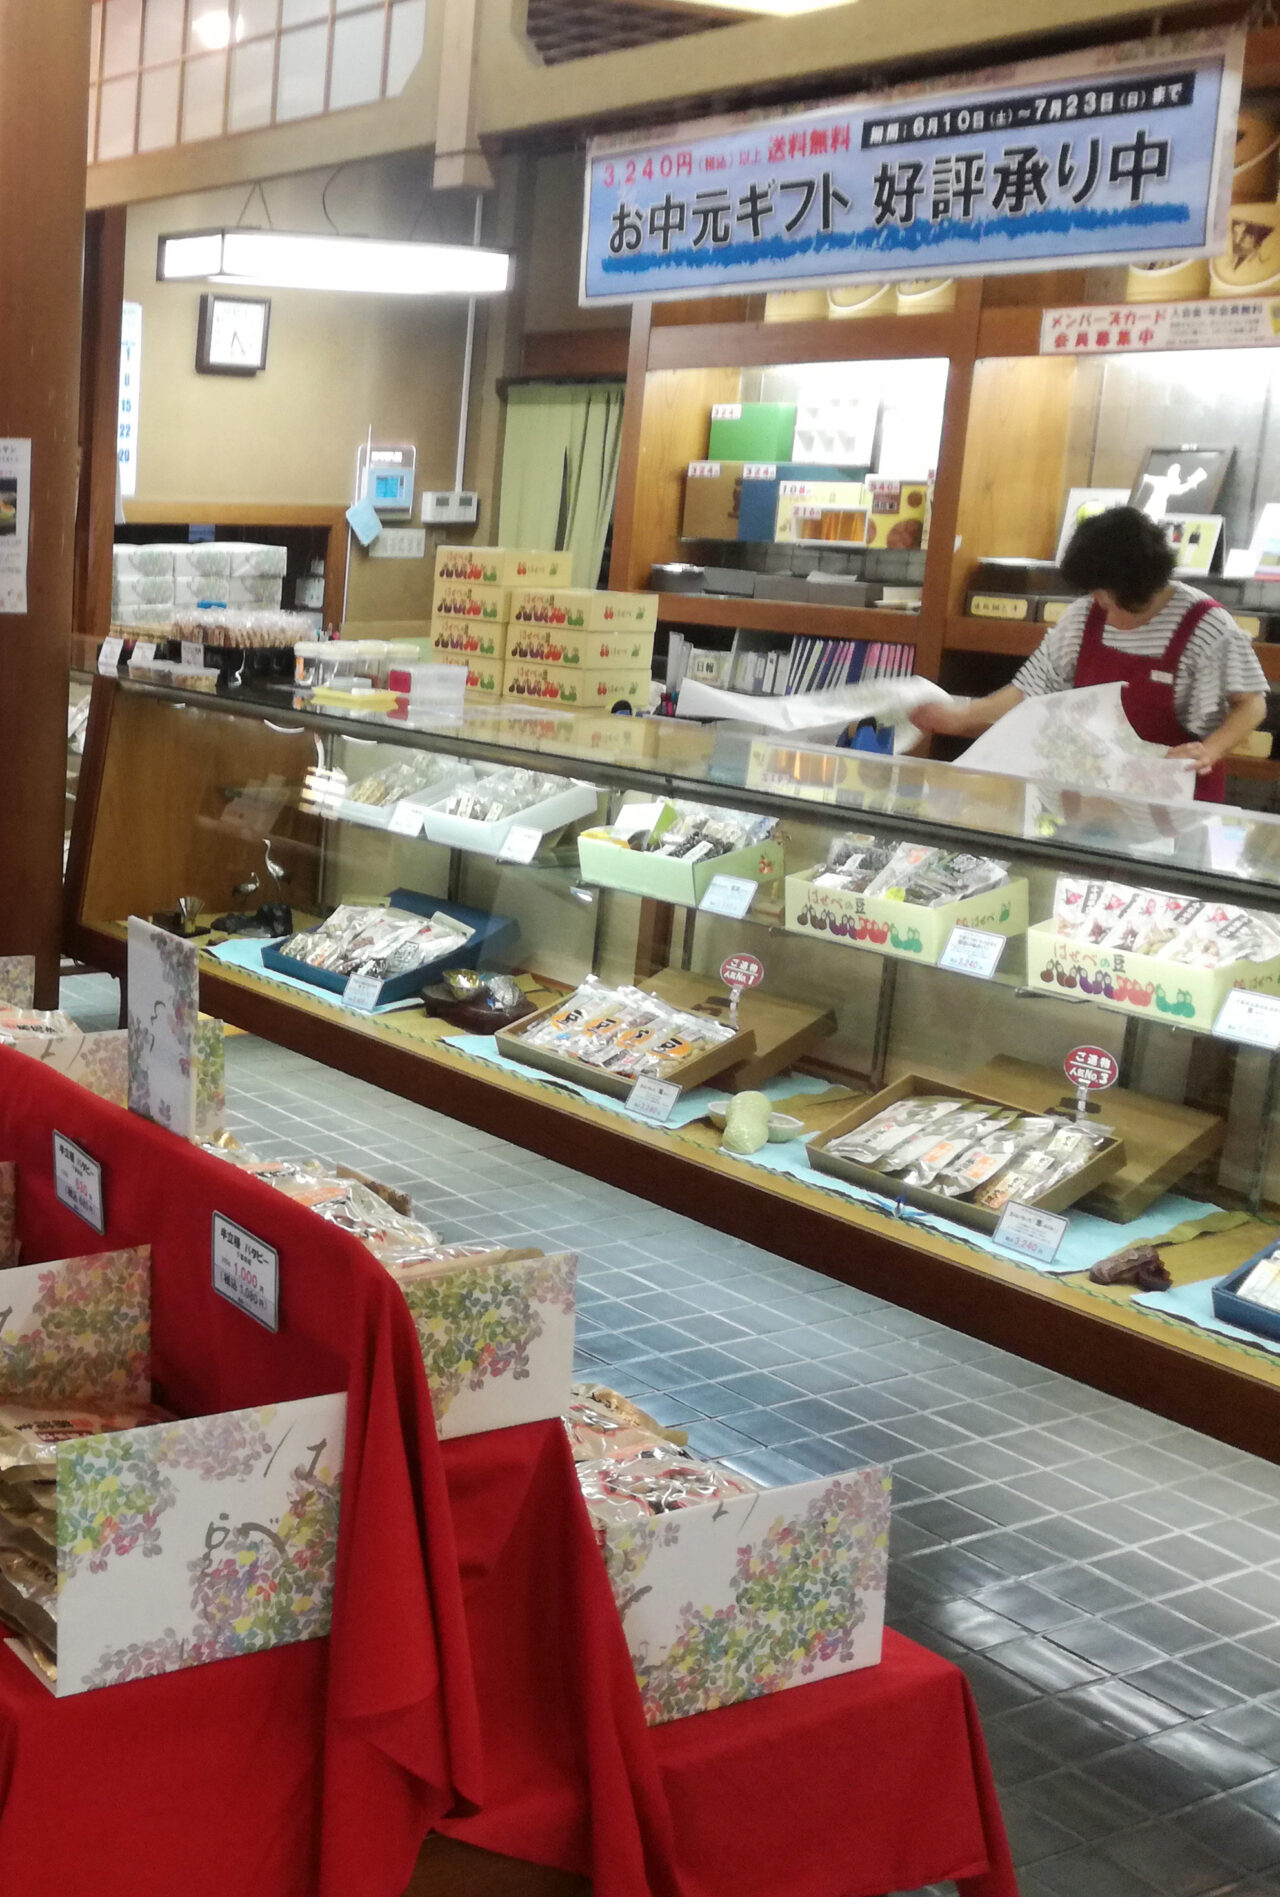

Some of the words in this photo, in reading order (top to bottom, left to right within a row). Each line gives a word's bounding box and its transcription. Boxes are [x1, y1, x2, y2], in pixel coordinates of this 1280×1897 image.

[767, 123, 851, 164] 送料無料
[609, 170, 851, 254] お中元ギフト
[872, 128, 1173, 226] 好評承り中
